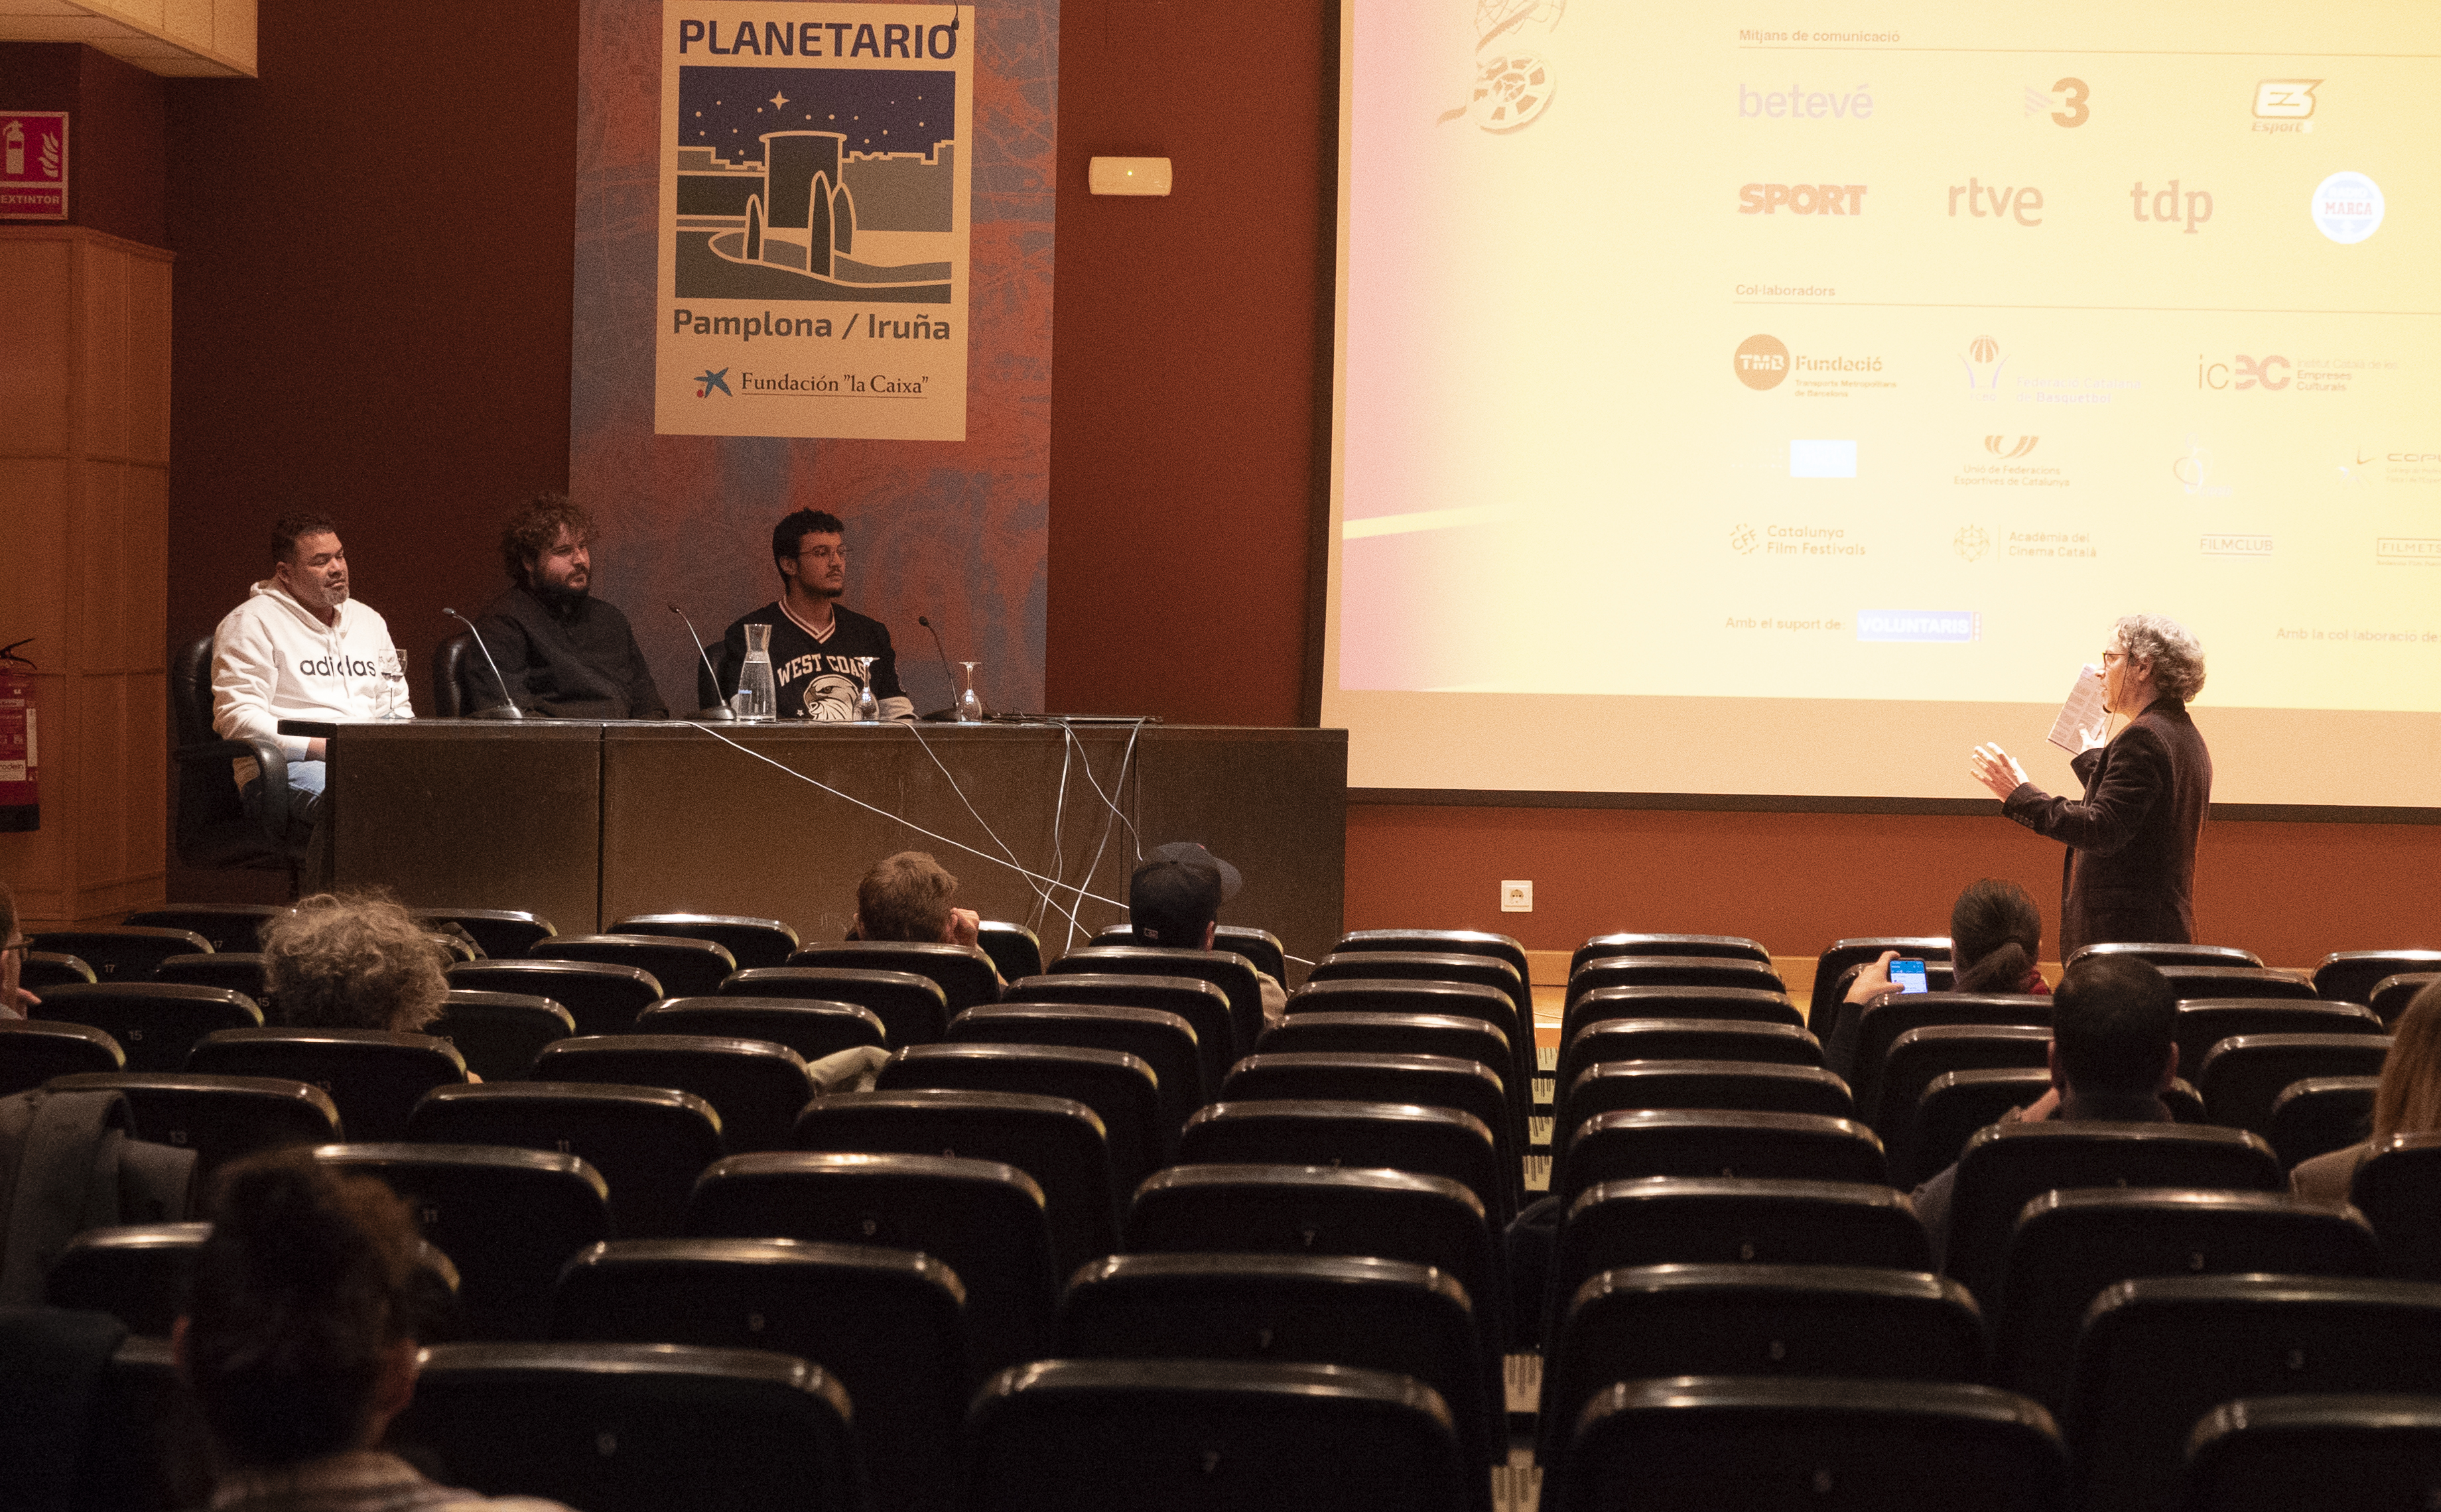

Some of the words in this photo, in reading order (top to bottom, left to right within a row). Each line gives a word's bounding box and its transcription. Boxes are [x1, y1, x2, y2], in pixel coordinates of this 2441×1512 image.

[679, 19, 957, 60] PLANETARIO
[1739, 29, 1788, 44] Mitjans
[1792, 30, 1809, 42] de
[1812, 31, 1900, 42] comunicació
[1738, 82, 1875, 119] betevé
[0, 194, 59, 204] EXTINTOR
[1737, 183, 1868, 216] SPORT
[1947, 176, 2044, 227] rtve
[2130, 179, 2214, 234] tdp
[2324, 202, 2373, 215] MARCA
[1735, 284, 1836, 296] Col·laboradors
[673, 308, 832, 342] Pamplona
[841, 313, 860, 340] /
[868, 314, 951, 340] Iruña
[1739, 354, 1785, 371] TMB
[1795, 355, 1882, 371] Fundació
[742, 372, 839, 391] Fundación
[2297, 369, 2353, 380] Empreses
[2016, 376, 2079, 389] Federació
[2084, 377, 2141, 389] Catalana
[2297, 381, 2347, 391] Culturals
[2016, 393, 2032, 403] de
[2036, 392, 2111, 405] Basquetbol
[1963, 465, 1986, 473] Unió
[1988, 466, 2001, 474] de
[2003, 466, 2061, 475] Federacions
[1953, 475, 2005, 487] Esportives
[2007, 477, 2019, 486] de
[2022, 477, 2070, 488] Catalunya
[1732, 529, 1756, 550] CFF
[1767, 525, 1845, 540] Catalunya
[2009, 531, 2069, 542] Acadèmia
[2072, 532, 2090, 542] del
[1767, 541, 1797, 554] Film
[1802, 542, 1867, 556] Festivals
[2009, 545, 2055, 557] Cinema
[2058, 546, 2097, 558] Català
[2200, 538, 2274, 552] FILMCLUB
[1725, 617, 1757, 628] Amb
[1760, 617, 1773, 629] el
[1776, 617, 1821, 632] suport
[1859, 617, 1970, 633] VOLUNTARIS
[2276, 627, 2308, 639] Amb
[2312, 629, 2324, 639] la
[300, 655, 376, 676] adidas
[777, 653, 822, 687] WEST
[826, 655, 871, 682] COAS
[214, 940, 223, 948] 17
[104, 964, 115, 974] 17
[257, 997, 271, 1007] 15
[128, 1030, 143, 1040] 15
[170, 1130, 187, 1144] 13
[557, 1139, 570, 1153] 11
[422, 1208, 438, 1224] 11
[862, 1219, 877, 1236] 9
[1303, 1229, 1316, 1247] 7
[2190, 1252, 2205, 1270] 3
